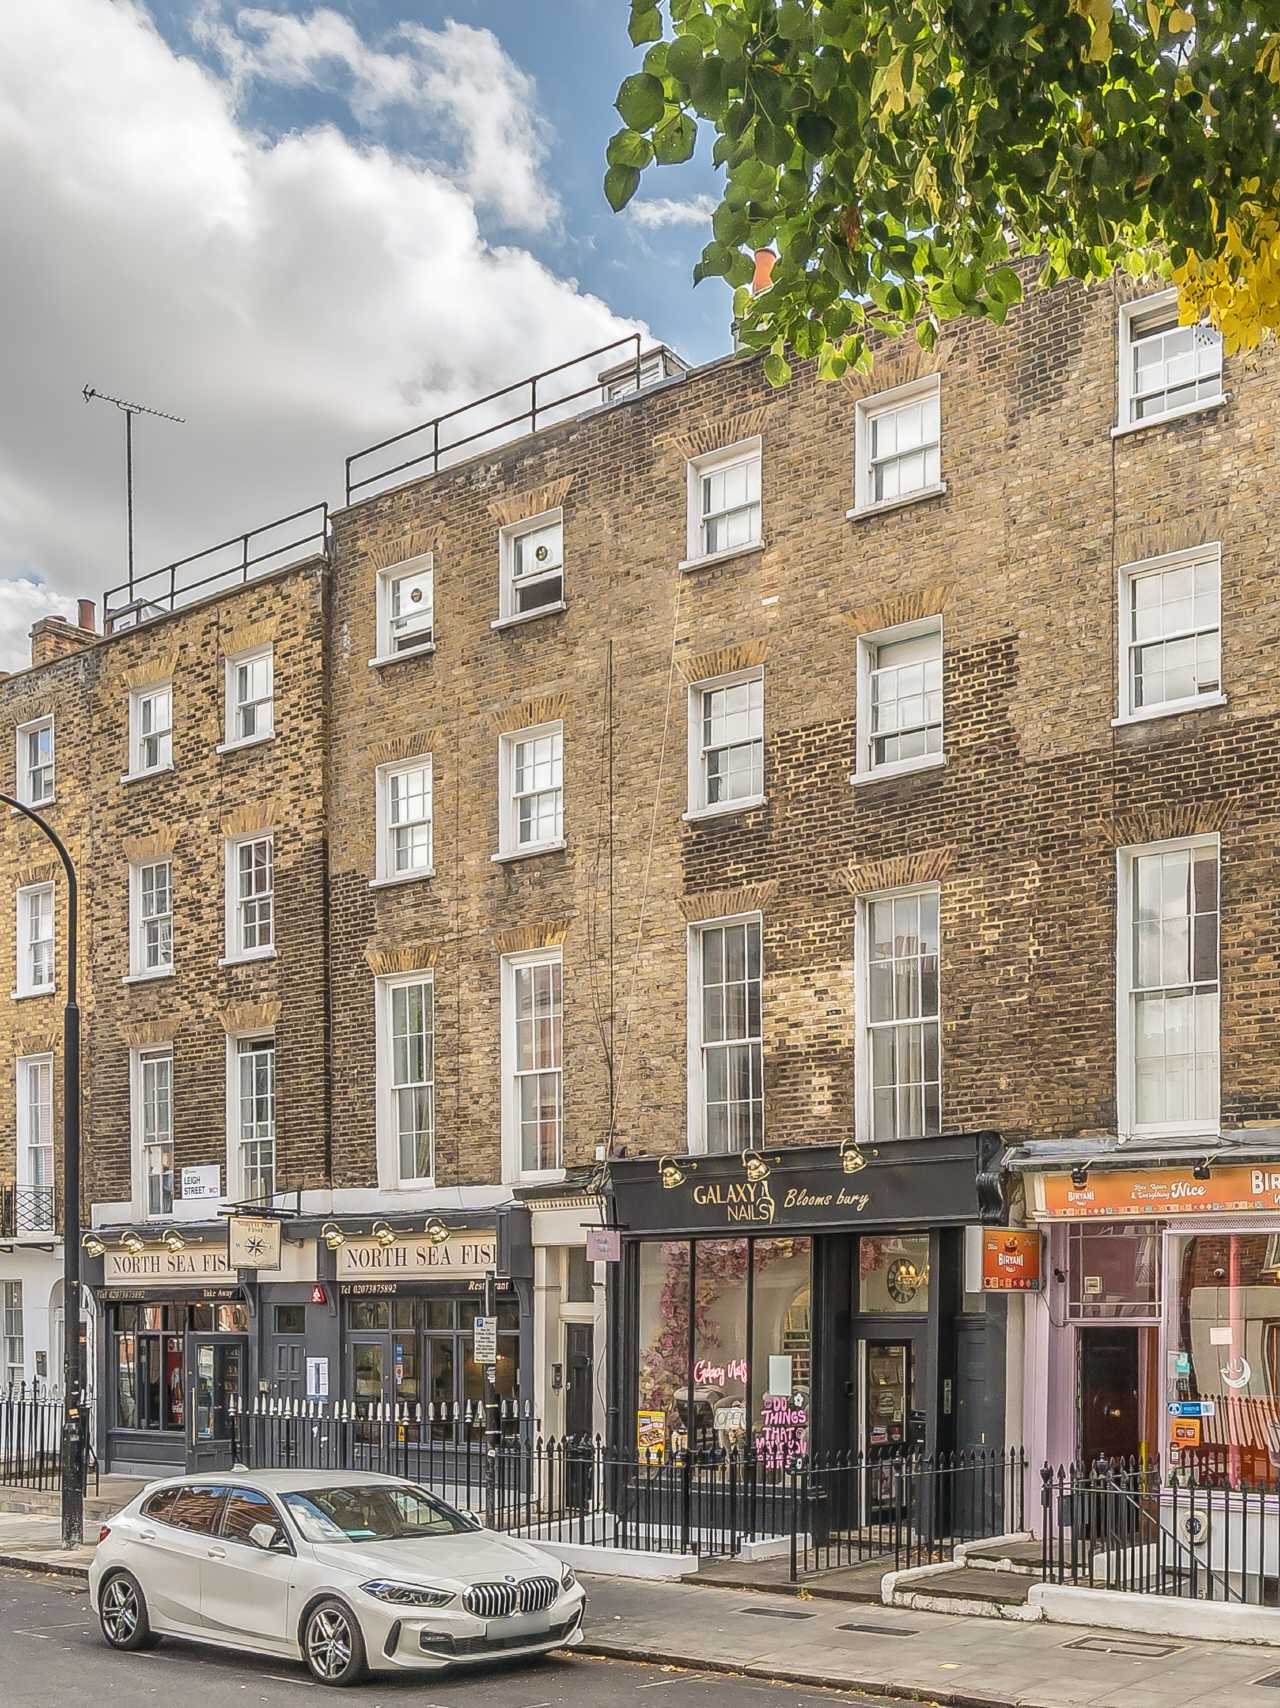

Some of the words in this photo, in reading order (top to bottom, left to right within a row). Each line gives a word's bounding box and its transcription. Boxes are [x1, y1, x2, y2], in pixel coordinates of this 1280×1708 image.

[184, 1176, 200, 1185] LEIGH
[1171, 1180, 1207, 1199] Nice
[184, 1186, 205, 1195] STREET
[693, 1183, 758, 1204] GALAXY
[783, 1188, 832, 1208] Blooms
[836, 1187, 869, 1212] bury
[727, 1203, 770, 1222] NAILS
[113, 1256, 161, 1274] NORTH
[167, 1254, 197, 1272] SEA
[203, 1254, 230, 1272] FIS
[347, 1247, 408, 1268] NORTH
[416, 1245, 452, 1266] SEA
[468, 1281, 509, 1291] Restrant
[761, 1410, 806, 1425] THINGS
[762, 1427, 795, 1443] THAT
